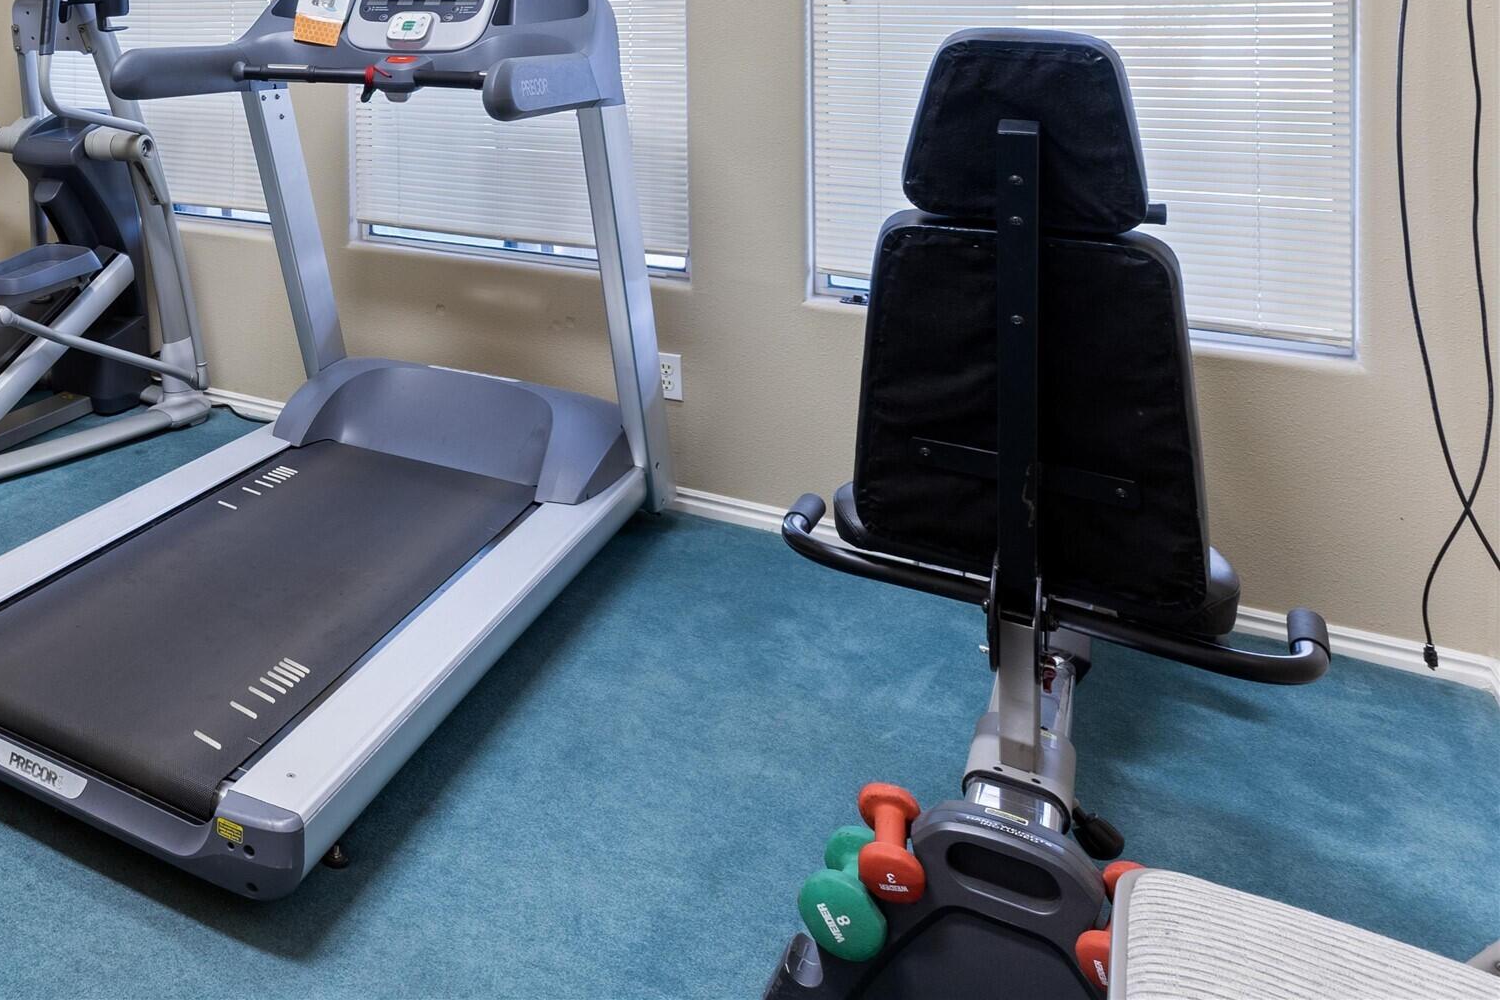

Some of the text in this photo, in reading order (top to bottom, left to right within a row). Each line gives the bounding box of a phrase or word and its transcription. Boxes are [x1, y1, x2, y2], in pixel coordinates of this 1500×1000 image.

[9, 751, 58, 787] PRECOR
[886, 872, 896, 884] 3
[879, 883, 909, 893] WEIDER
[816, 903, 845, 943] WEIDER
[837, 915, 851, 926] 8
